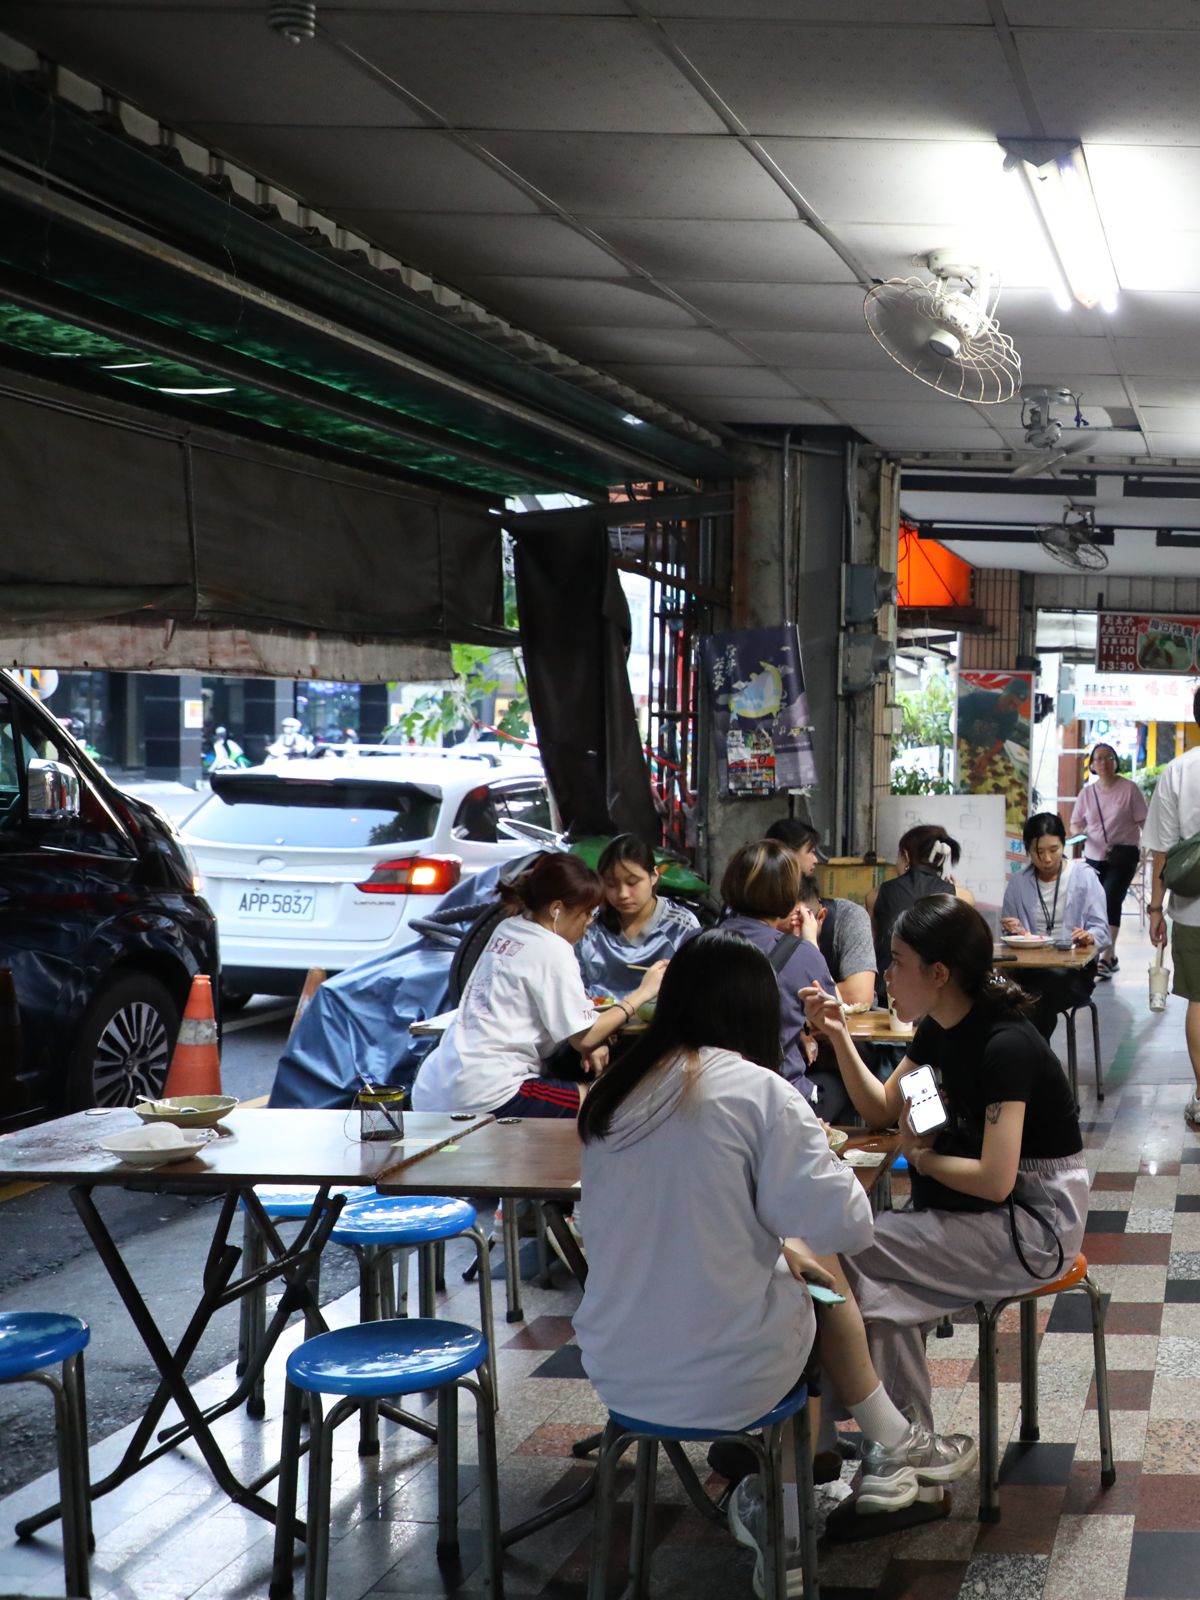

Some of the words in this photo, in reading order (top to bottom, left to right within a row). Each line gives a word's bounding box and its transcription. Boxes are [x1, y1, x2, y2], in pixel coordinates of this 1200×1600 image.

[1102, 646, 1135, 655] 11:00
[1102, 661, 1134, 671] 13:30
[239, 893, 313, 914] APP-5837
